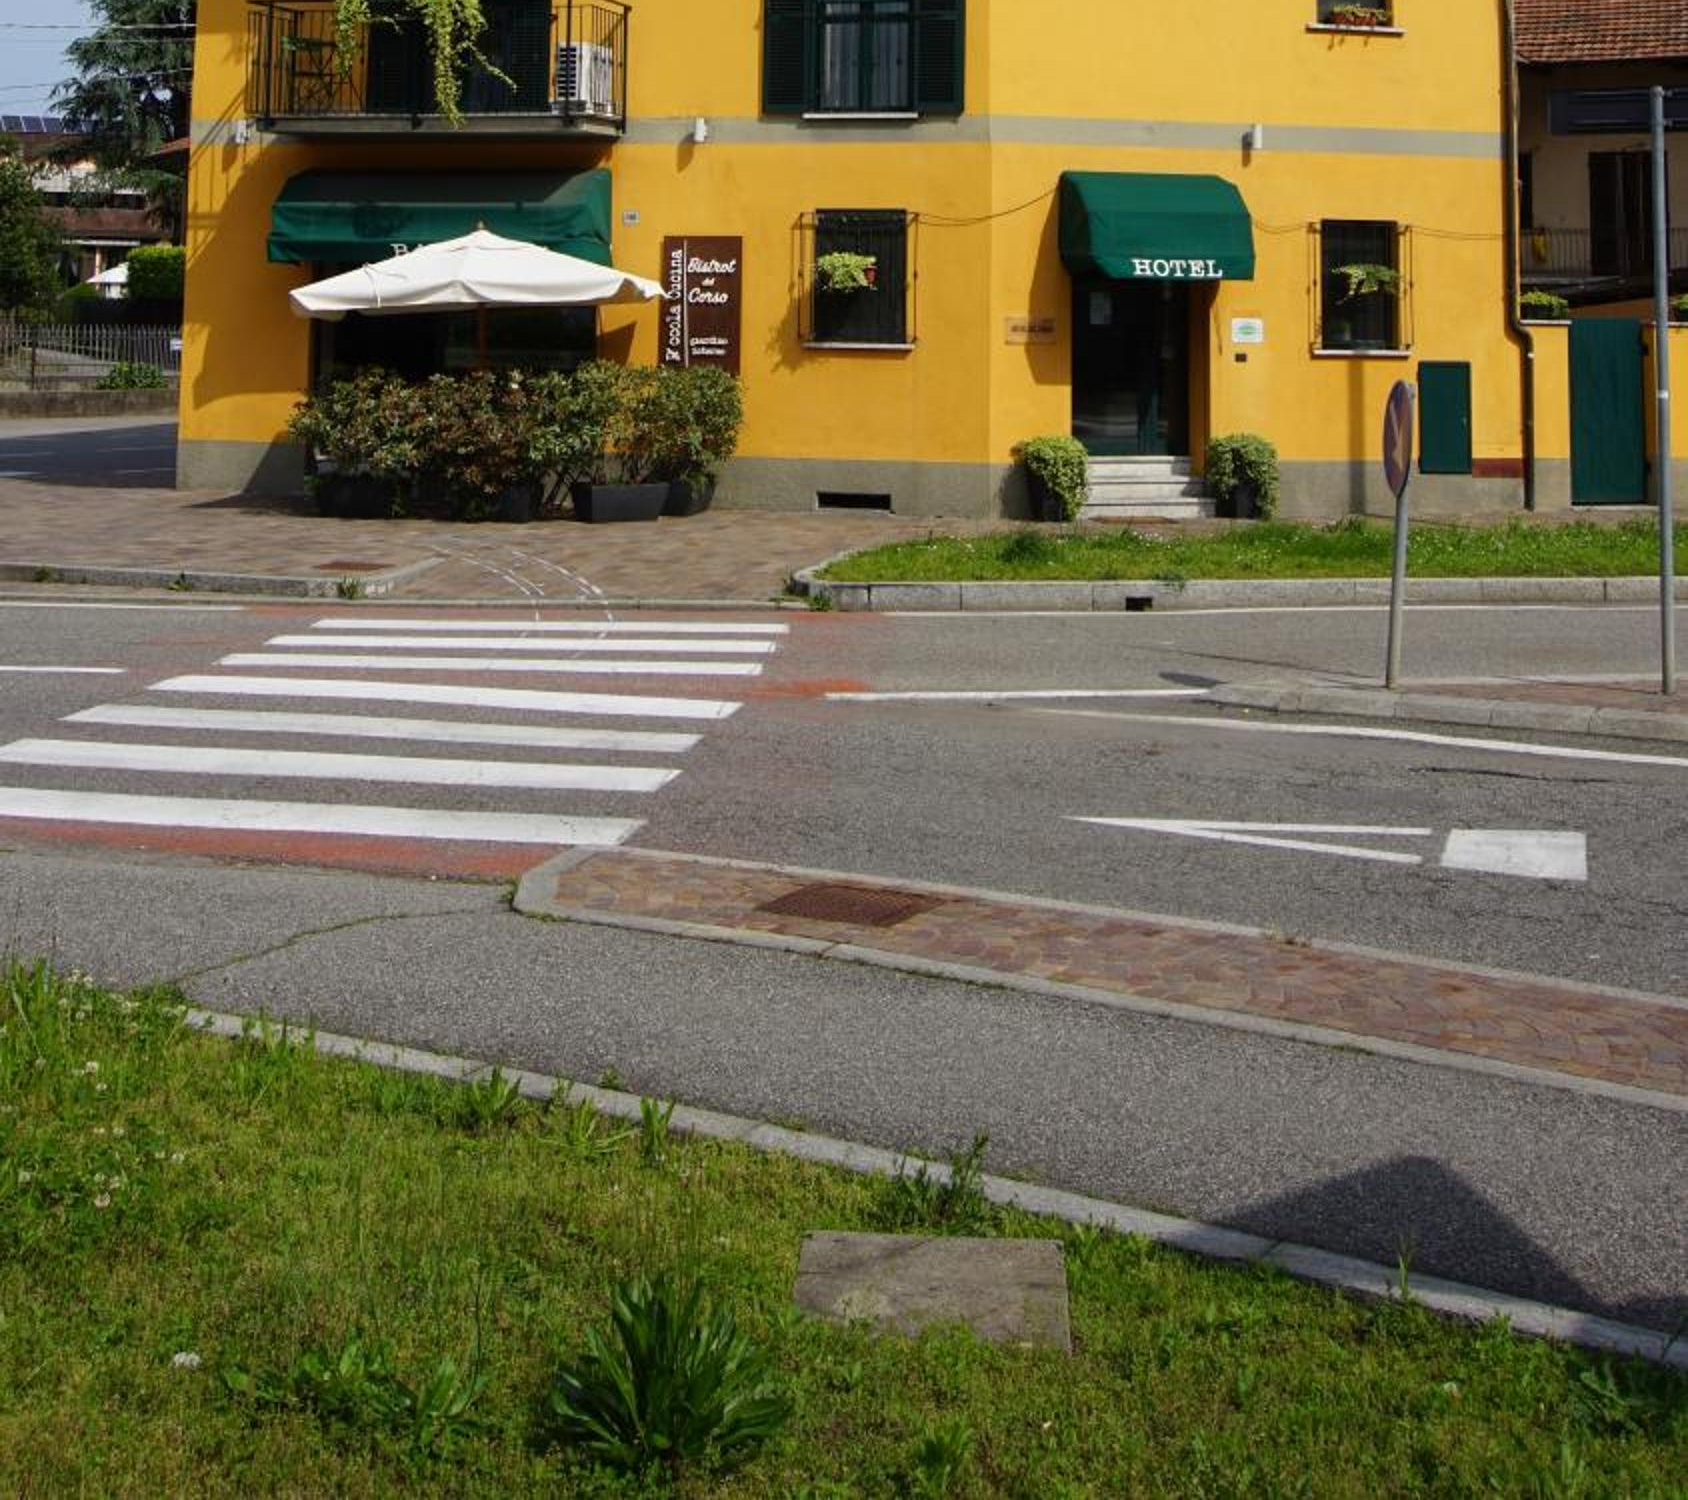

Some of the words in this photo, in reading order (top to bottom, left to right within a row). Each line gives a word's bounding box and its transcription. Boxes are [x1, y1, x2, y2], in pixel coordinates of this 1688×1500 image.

[687, 257, 737, 274] Bistrot
[1131, 258, 1223, 277] HOTEL
[688, 288, 729, 304] Corso
